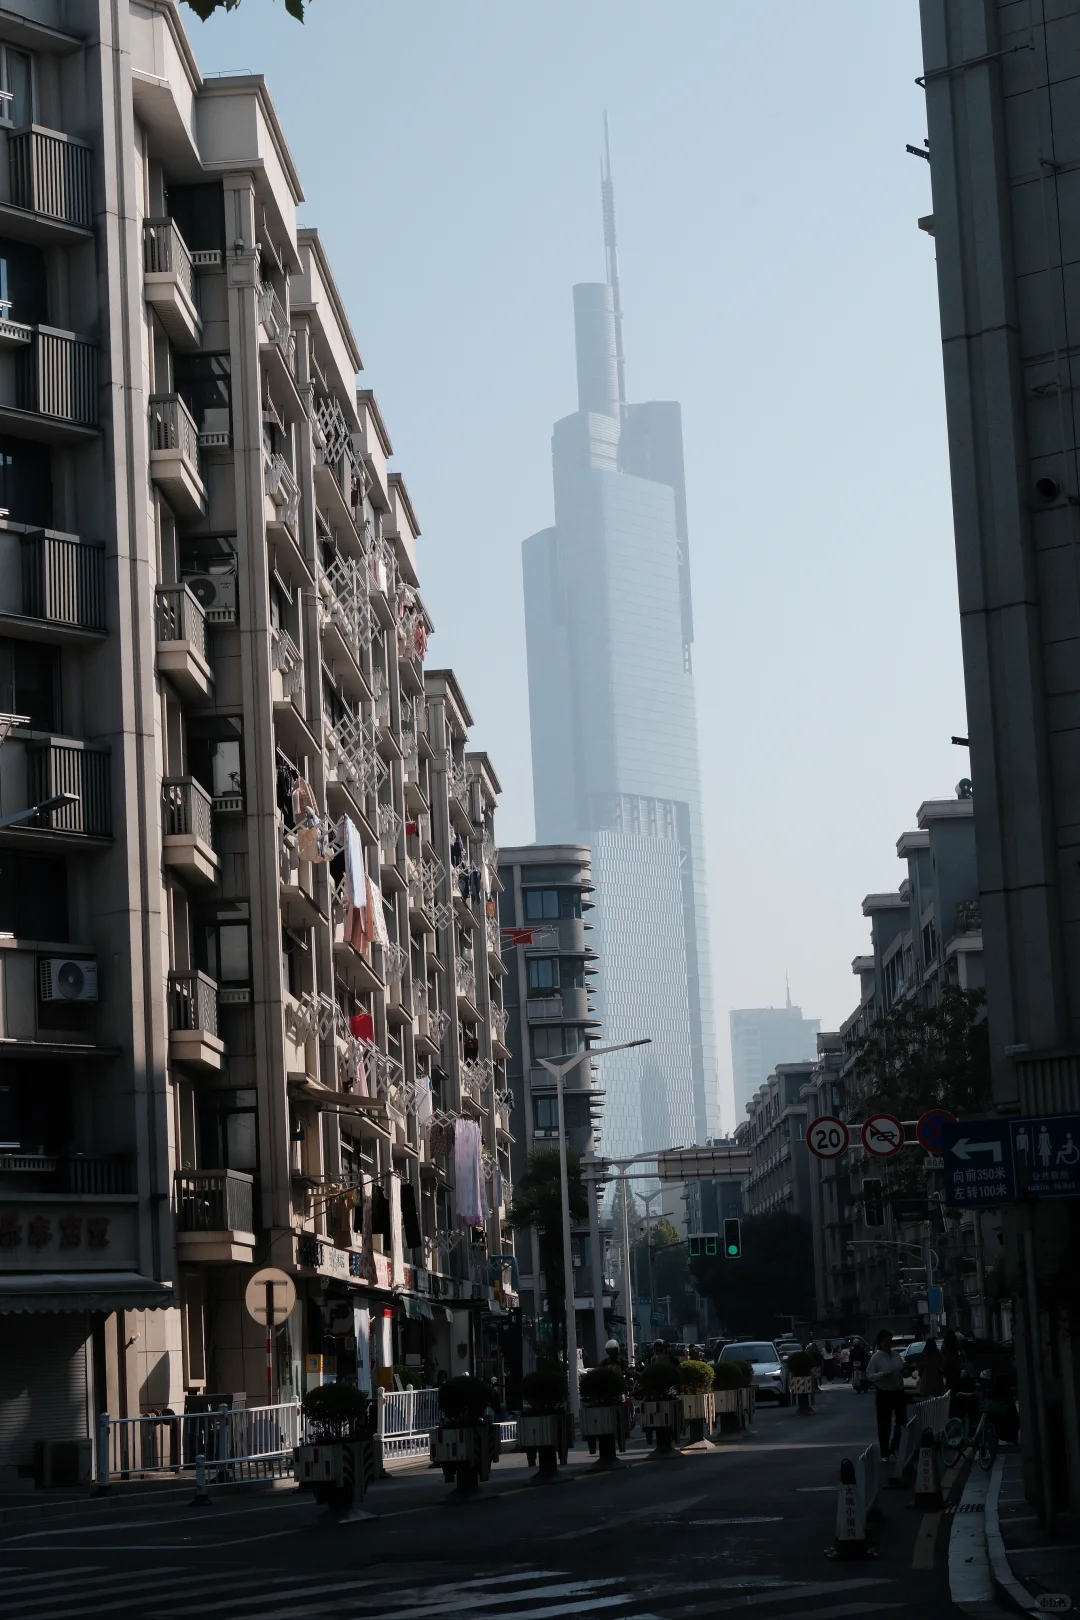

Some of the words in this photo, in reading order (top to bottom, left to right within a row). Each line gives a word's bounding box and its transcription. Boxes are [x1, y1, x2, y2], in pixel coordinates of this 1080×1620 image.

[816, 1129, 841, 1149] 20
[953, 1166, 1007, 1183] 向前350米
[1031, 1169, 1070, 1181] 公共厕所
[954, 1183, 1008, 1200] 左转100米
[1053, 1181, 1076, 1190] toilet
